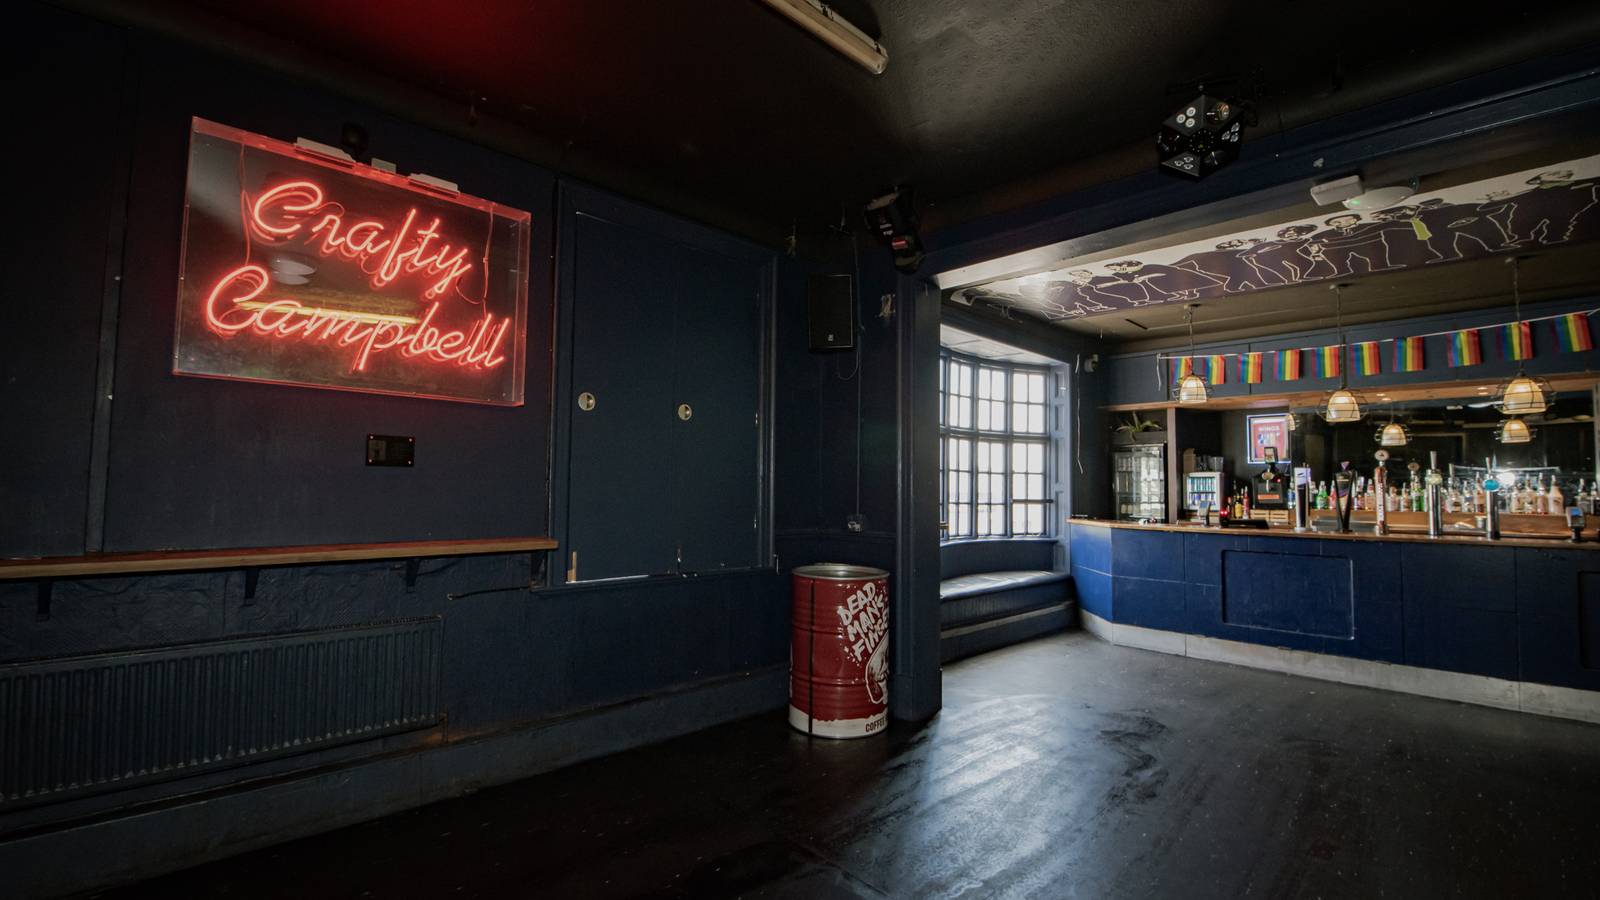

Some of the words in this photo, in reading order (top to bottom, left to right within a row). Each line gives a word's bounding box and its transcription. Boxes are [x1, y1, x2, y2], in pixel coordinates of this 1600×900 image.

[253, 180, 473, 294] Crafty
[206, 265, 510, 371] Campbell
[837, 582, 876, 625] DEAD
